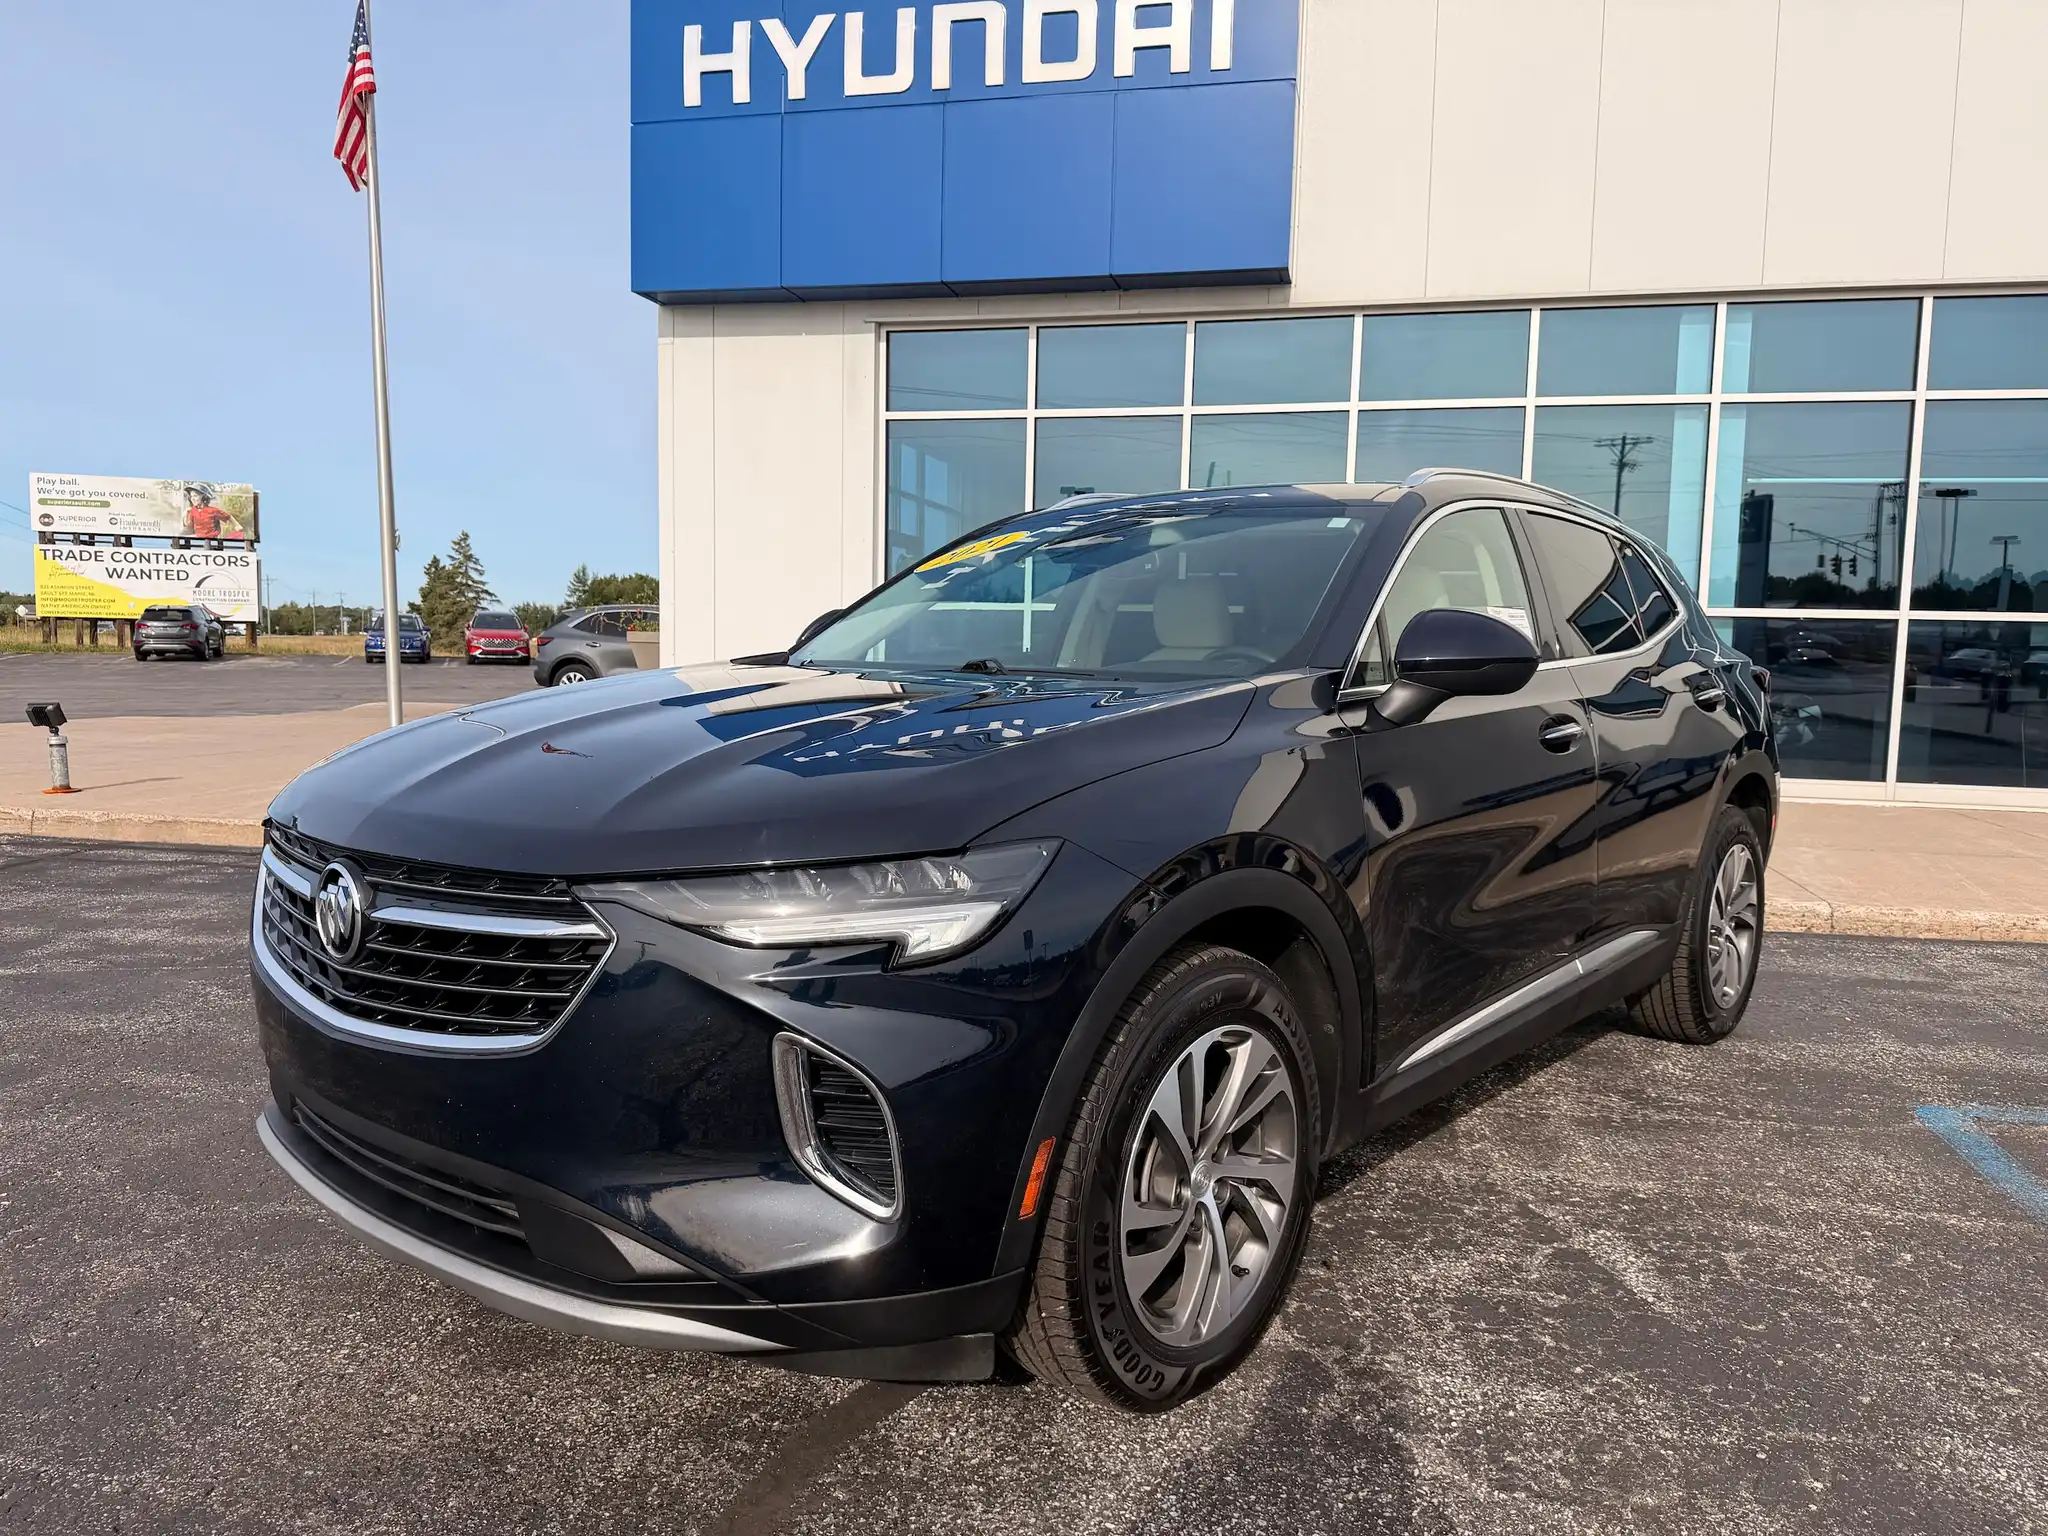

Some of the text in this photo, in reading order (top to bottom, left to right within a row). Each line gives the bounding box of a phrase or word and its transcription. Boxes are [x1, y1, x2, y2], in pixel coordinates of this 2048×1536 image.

[683, 0, 1233, 106] HYUNDAI
[36, 477, 80, 487] Play ball.
[37, 487, 149, 500] We've got you covered.
[58, 515, 97, 523] SUPERIOR
[39, 548, 250, 567] TRADE CONTRACTORS
[105, 567, 189, 581] WANTED
[192, 589, 250, 598] MOORE TROSPER
